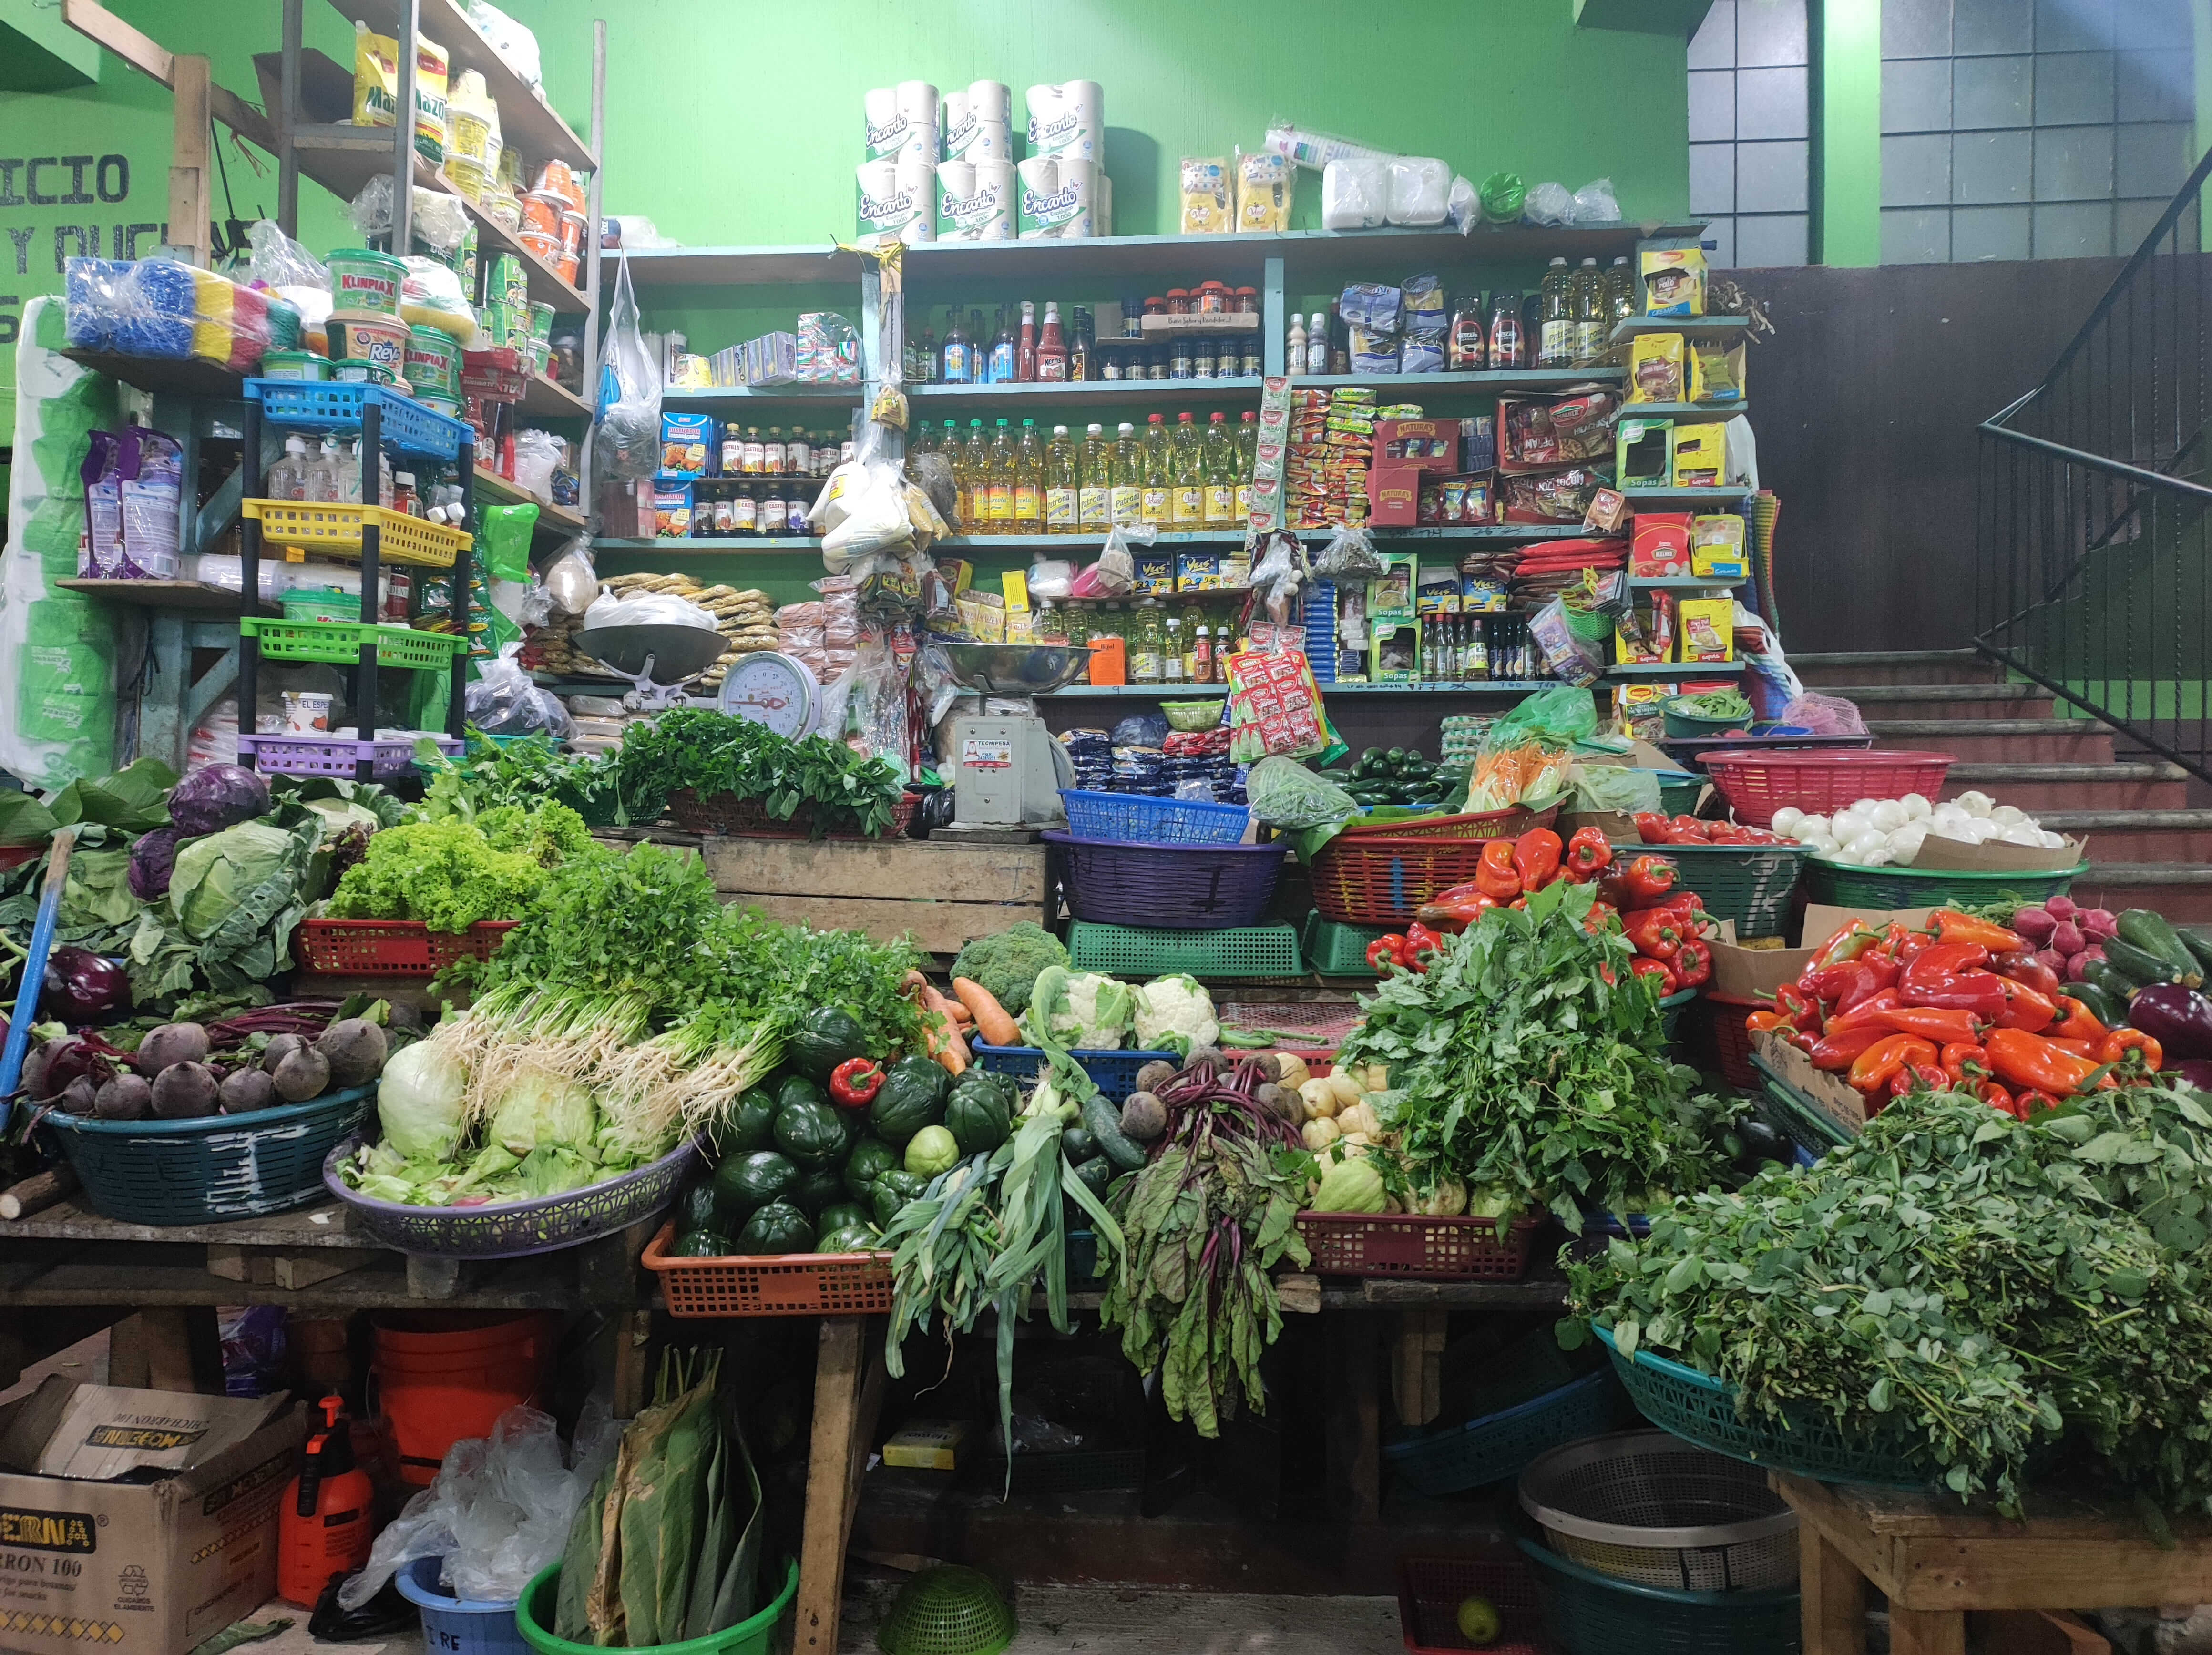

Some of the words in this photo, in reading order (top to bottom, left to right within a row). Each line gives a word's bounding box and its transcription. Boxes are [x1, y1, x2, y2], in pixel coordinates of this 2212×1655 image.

[866, 113, 907, 148] Encanto
[1028, 111, 1077, 143] Encanto
[860, 192, 912, 220] Encanto
[941, 190, 995, 218] Encanto
[1023, 187, 1077, 215] Encanto
[7, 226, 35, 274] Y
[342, 274, 395, 297] KLINPIAX
[1631, 479, 1657, 487] Sopas
[1081, 494, 1105, 509] Patrona
[1116, 492, 1140, 508] Patrona
[1142, 562, 1167, 573] Yus
[1186, 558, 1210, 571] Yus
[1426, 587, 1450, 596] Yus
[1378, 608, 1402, 616] Sopas
[1384, 672, 1407, 680] Sopas
[52, 1558, 83, 1578] 100
